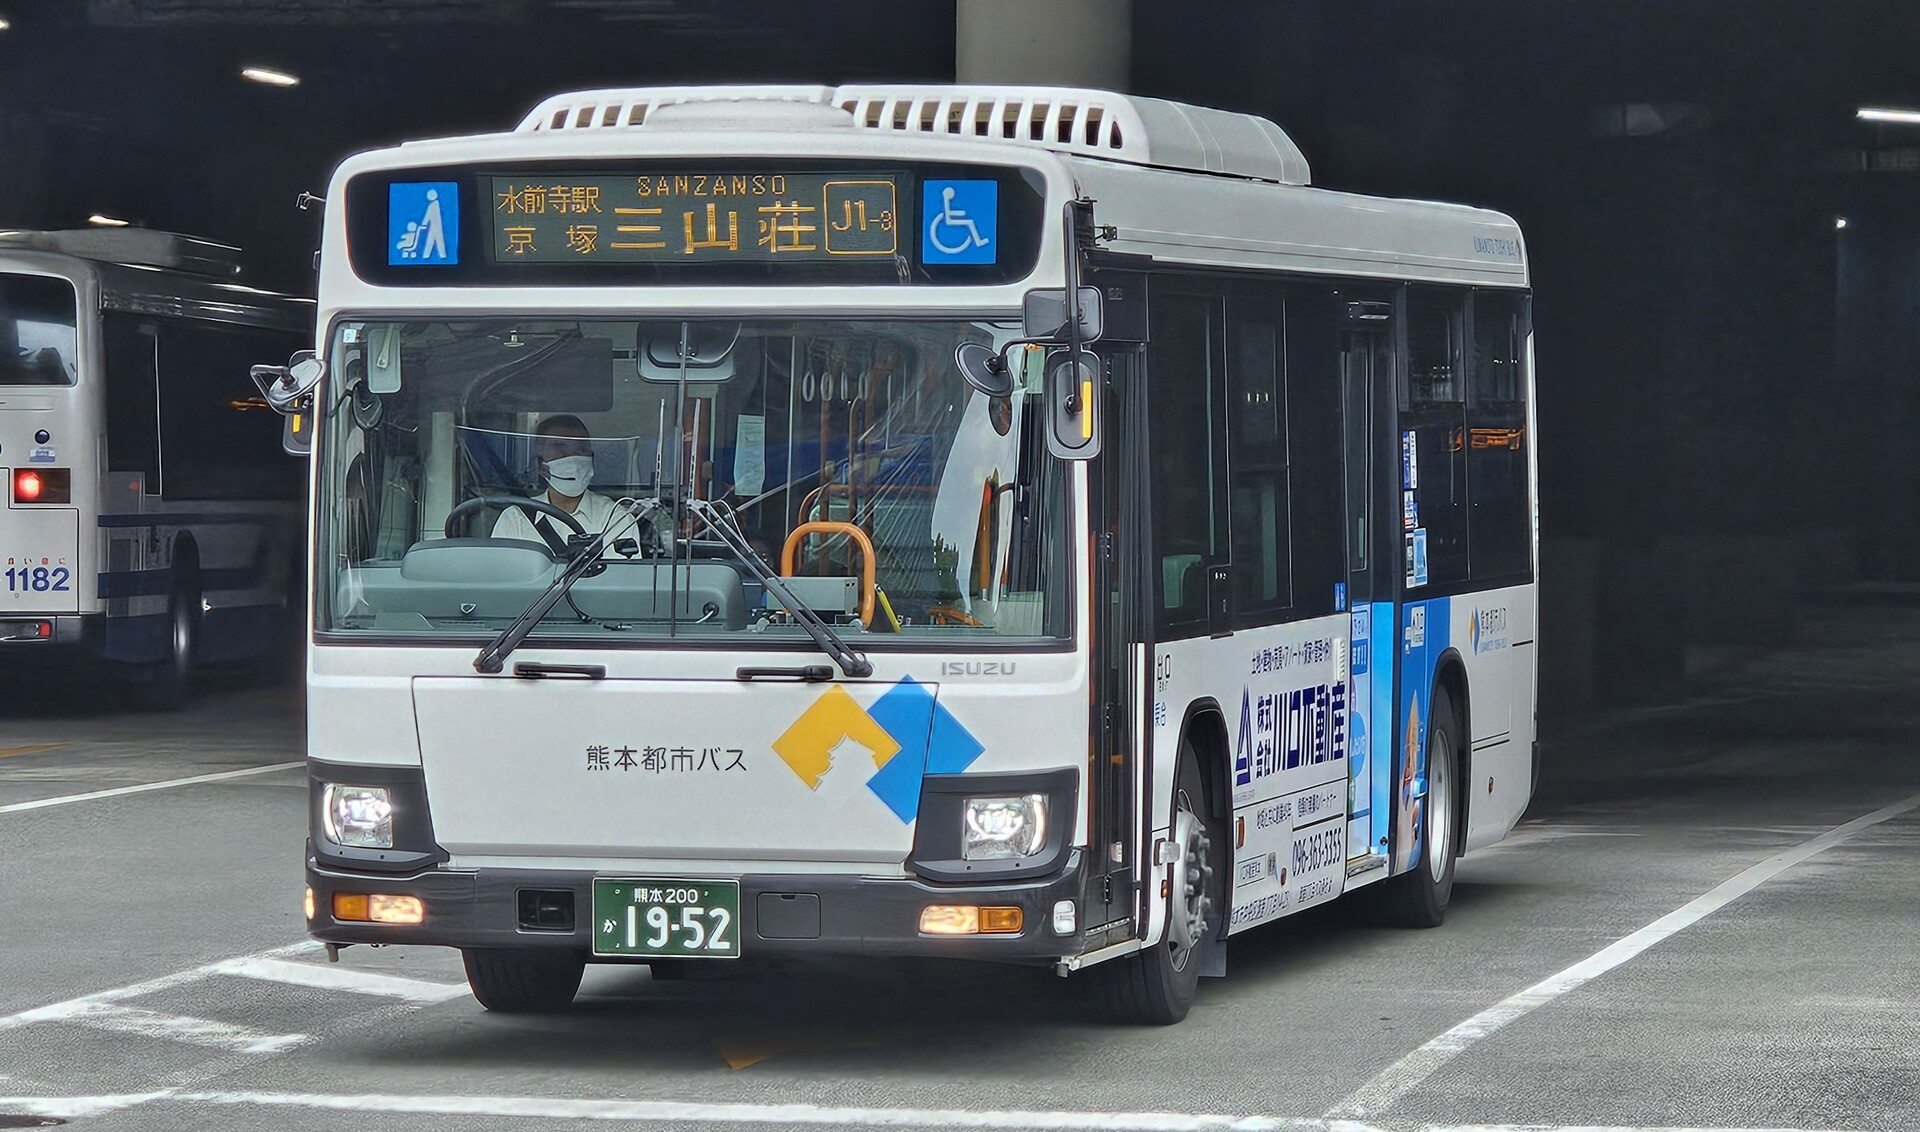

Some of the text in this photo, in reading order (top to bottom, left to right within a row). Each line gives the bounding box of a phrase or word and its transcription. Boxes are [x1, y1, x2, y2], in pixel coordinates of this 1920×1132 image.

[497, 185, 602, 214] 水前寺駅
[637, 176, 786, 196] SANZANSO
[610, 200, 817, 254] 三山荘
[5, 567, 70, 591] 1182
[941, 661, 1017, 676] ISUZU
[585, 744, 748, 773] 熊本都市バス
[627, 905, 731, 950] 19-52
